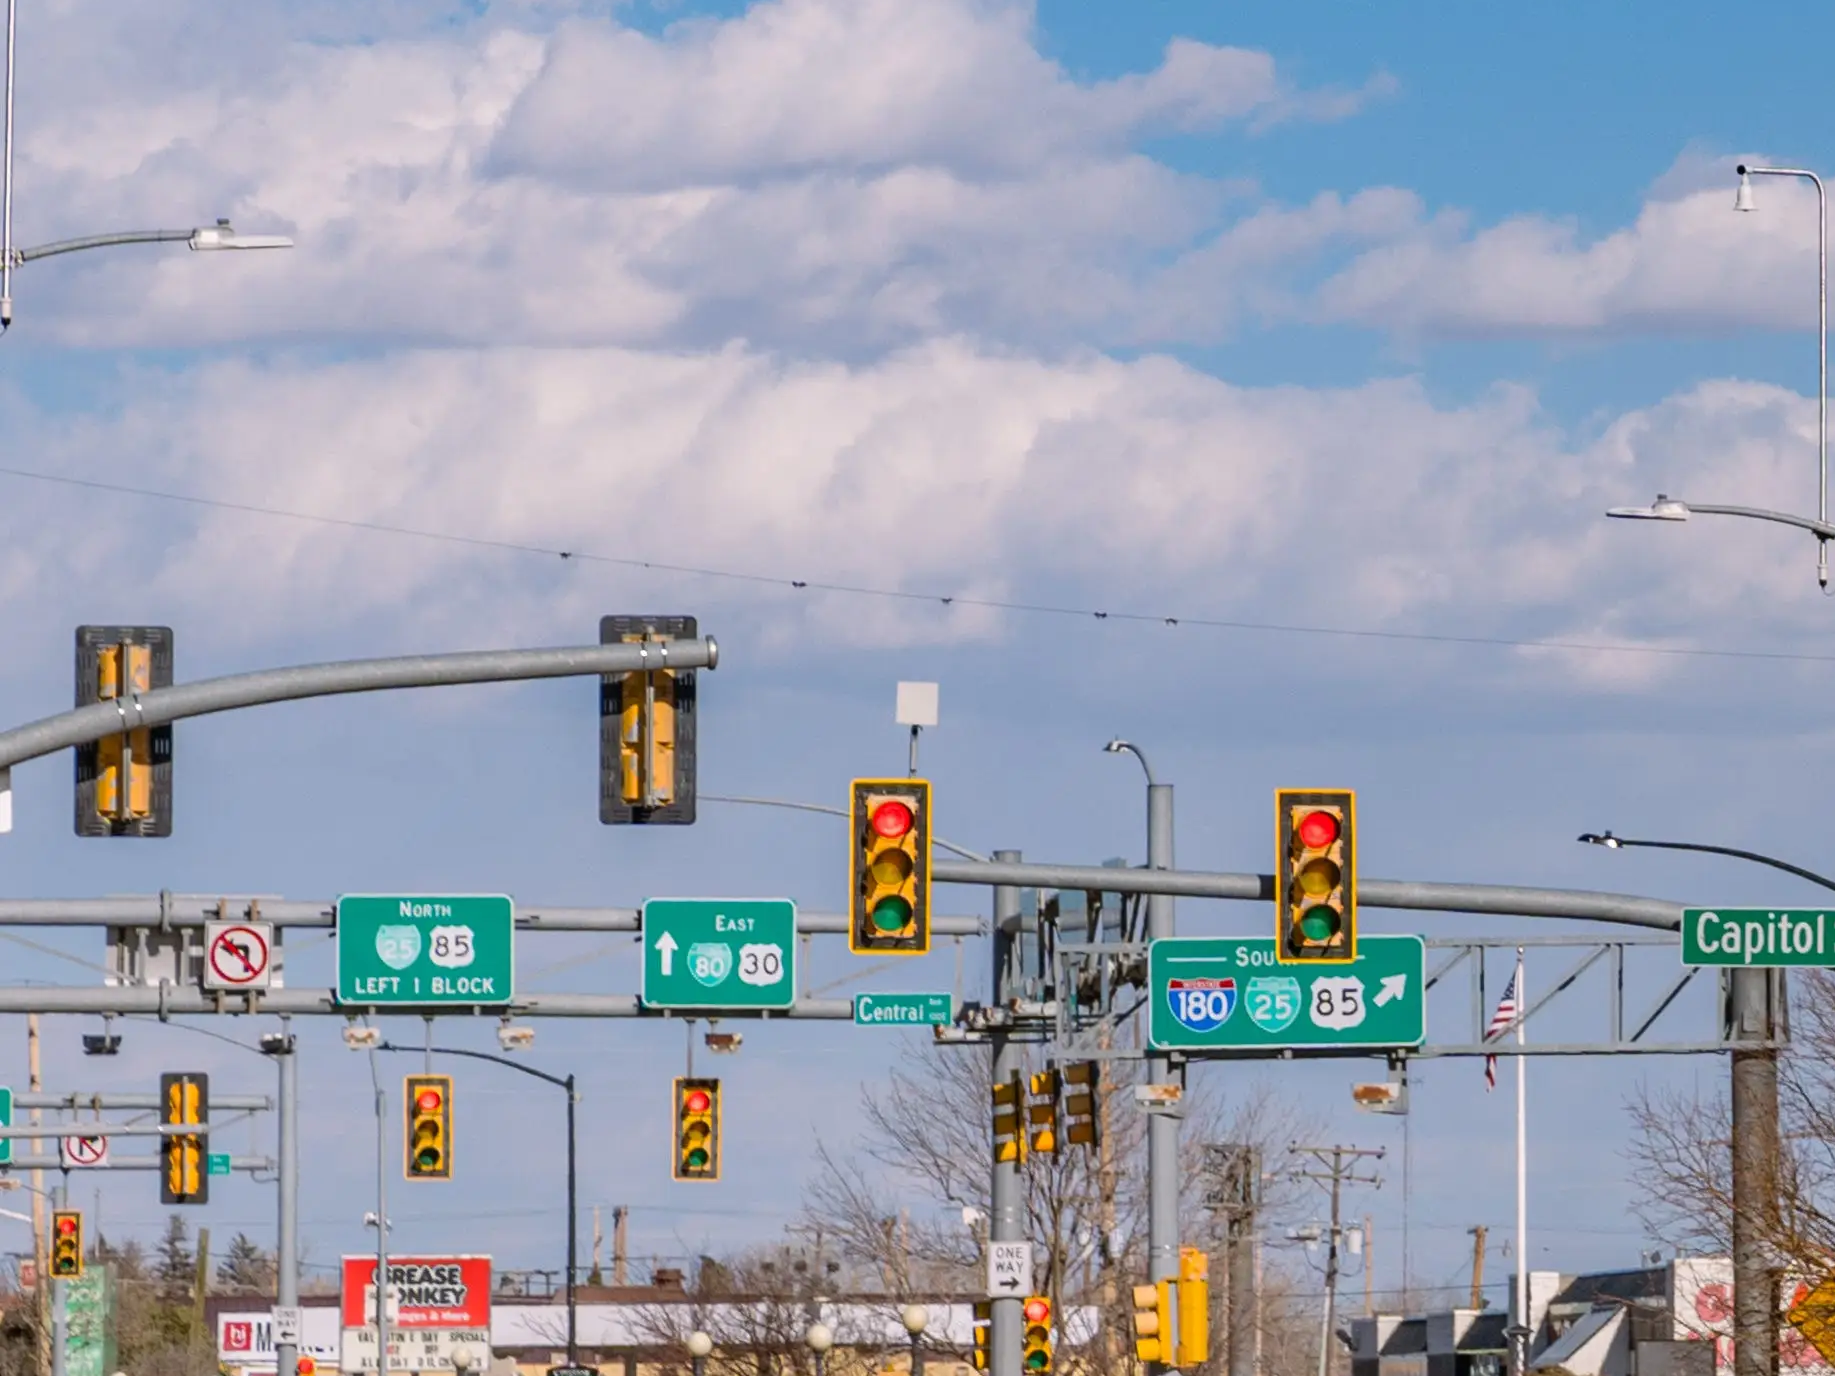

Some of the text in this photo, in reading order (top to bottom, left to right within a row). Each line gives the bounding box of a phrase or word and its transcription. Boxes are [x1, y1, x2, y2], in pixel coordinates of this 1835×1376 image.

[399, 900, 452, 918] NORTH
[714, 915, 756, 933] EAST
[382, 934, 471, 961] 25 85
[1696, 911, 1826, 965] Capitol
[695, 953, 780, 978] 80 30
[354, 977, 495, 995] LEFT 1 BLOCK
[858, 996, 924, 1022] Central
[1177, 988, 1359, 1022] 180 25 85
[995, 1246, 1025, 1259] ONE
[995, 1261, 1024, 1275] WAY
[397, 1286, 467, 1305] ONKEY
